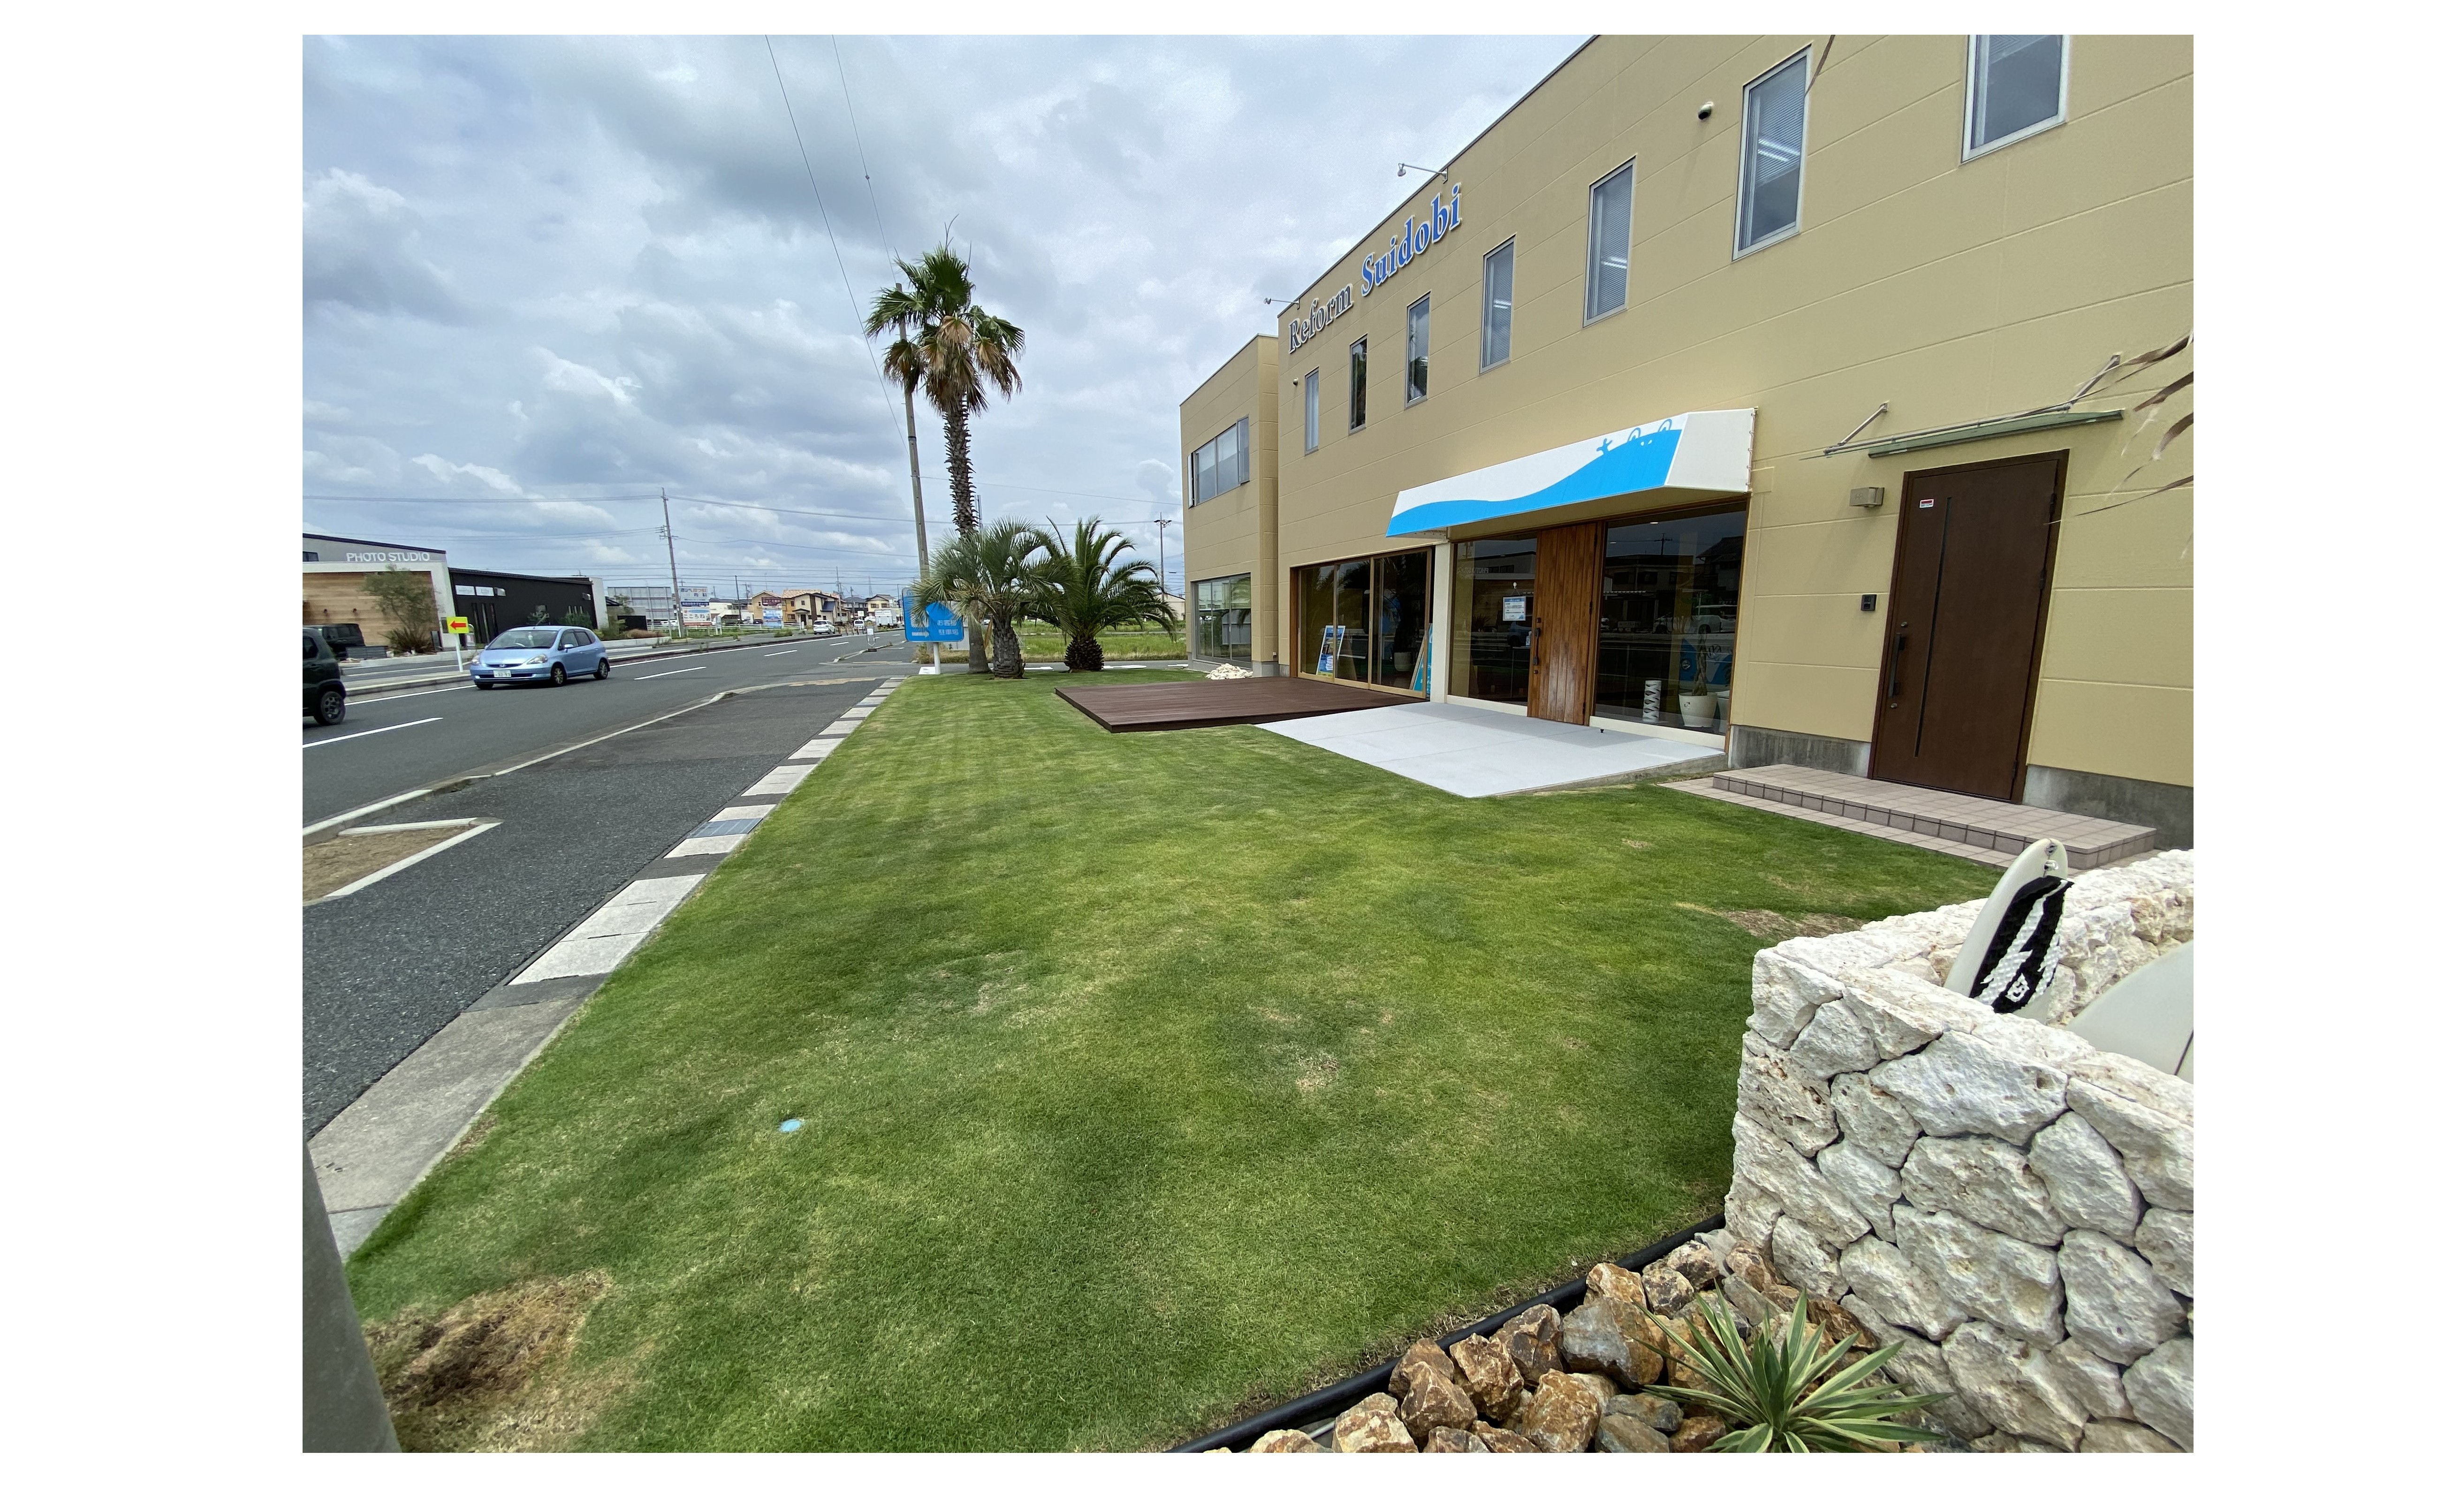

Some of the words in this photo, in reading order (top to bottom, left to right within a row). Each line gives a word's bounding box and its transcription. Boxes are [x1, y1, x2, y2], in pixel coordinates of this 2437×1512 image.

[1289, 283, 1354, 354] Reform
[1361, 182, 1462, 296] Suidobi
[346, 553, 386, 562] PHOTO
[388, 552, 430, 561] STUDIO
